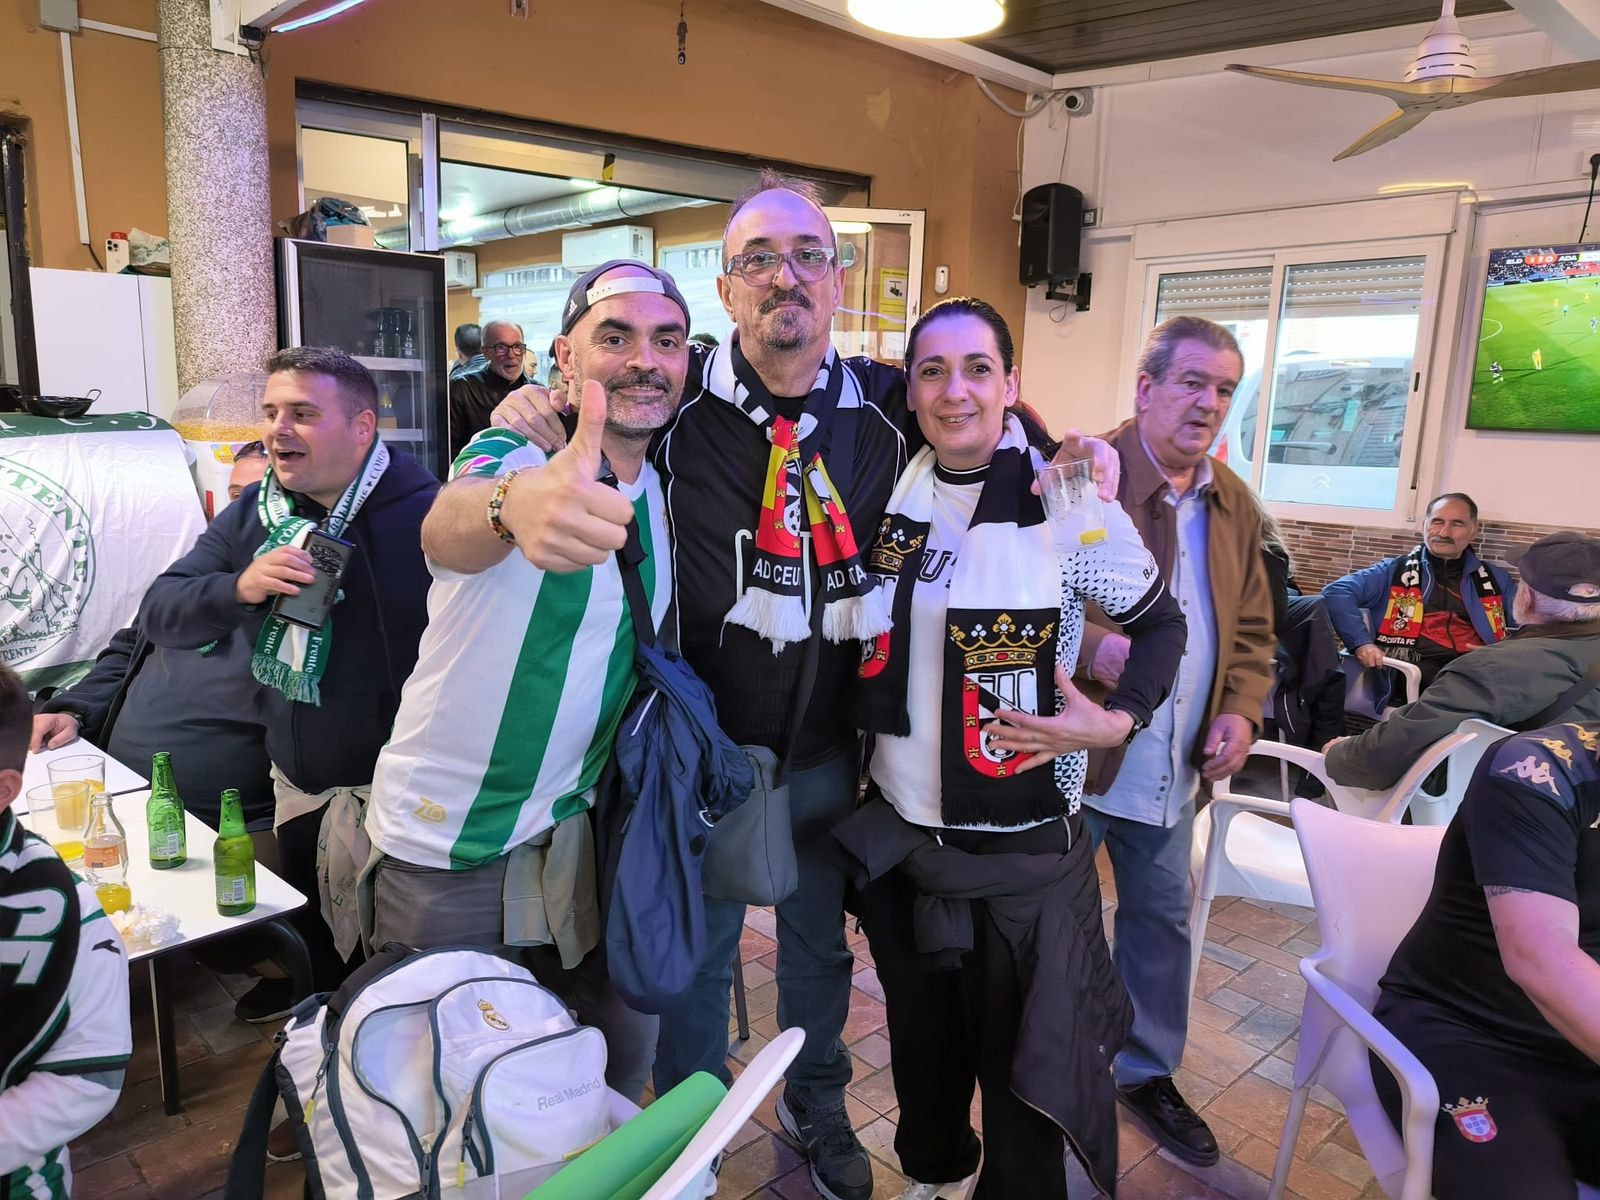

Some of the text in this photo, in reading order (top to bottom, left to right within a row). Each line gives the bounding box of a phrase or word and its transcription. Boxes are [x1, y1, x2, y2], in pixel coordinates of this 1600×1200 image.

[752, 557, 772, 580] AD
[826, 568, 845, 592] AD
[305, 636, 323, 674] Frente
[537, 1078, 601, 1111] Real Madrid
